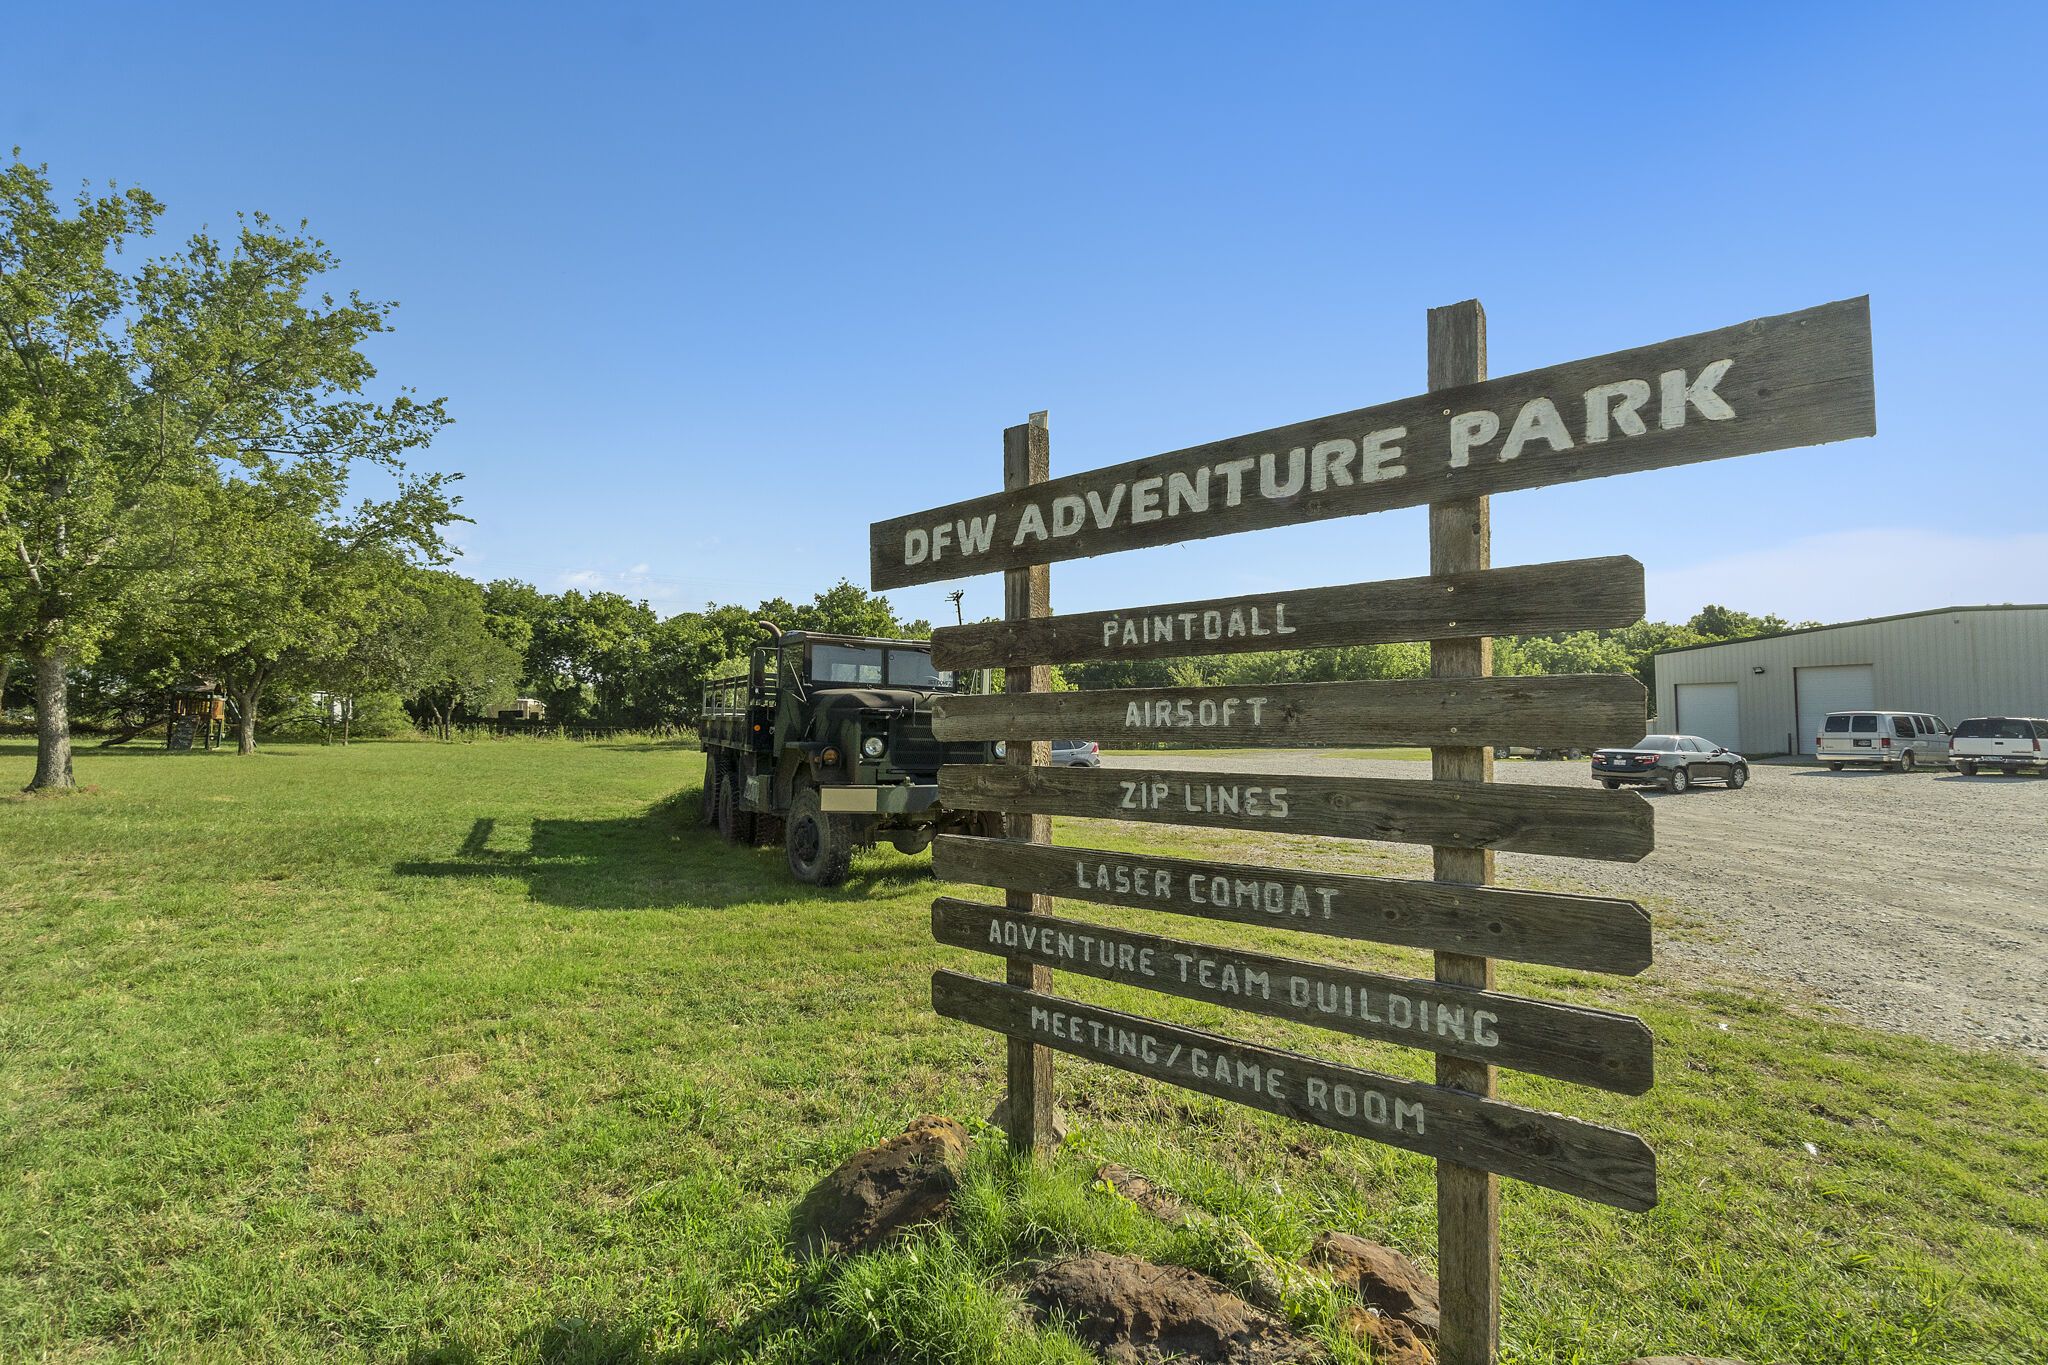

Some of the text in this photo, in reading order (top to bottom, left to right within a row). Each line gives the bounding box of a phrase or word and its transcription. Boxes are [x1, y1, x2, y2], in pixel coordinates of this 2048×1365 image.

[904, 358, 1736, 565] DFW ADVENTURE PARK
[1125, 696, 1269, 727] AIRSOFT
[1119, 780, 1289, 818] ZIP LINES
[1076, 861, 1171, 900] LASER
[989, 918, 1156, 977] ADVENTURE
[1173, 953, 1271, 1000] TEAM
[1307, 1076, 1425, 1135] ROOM
